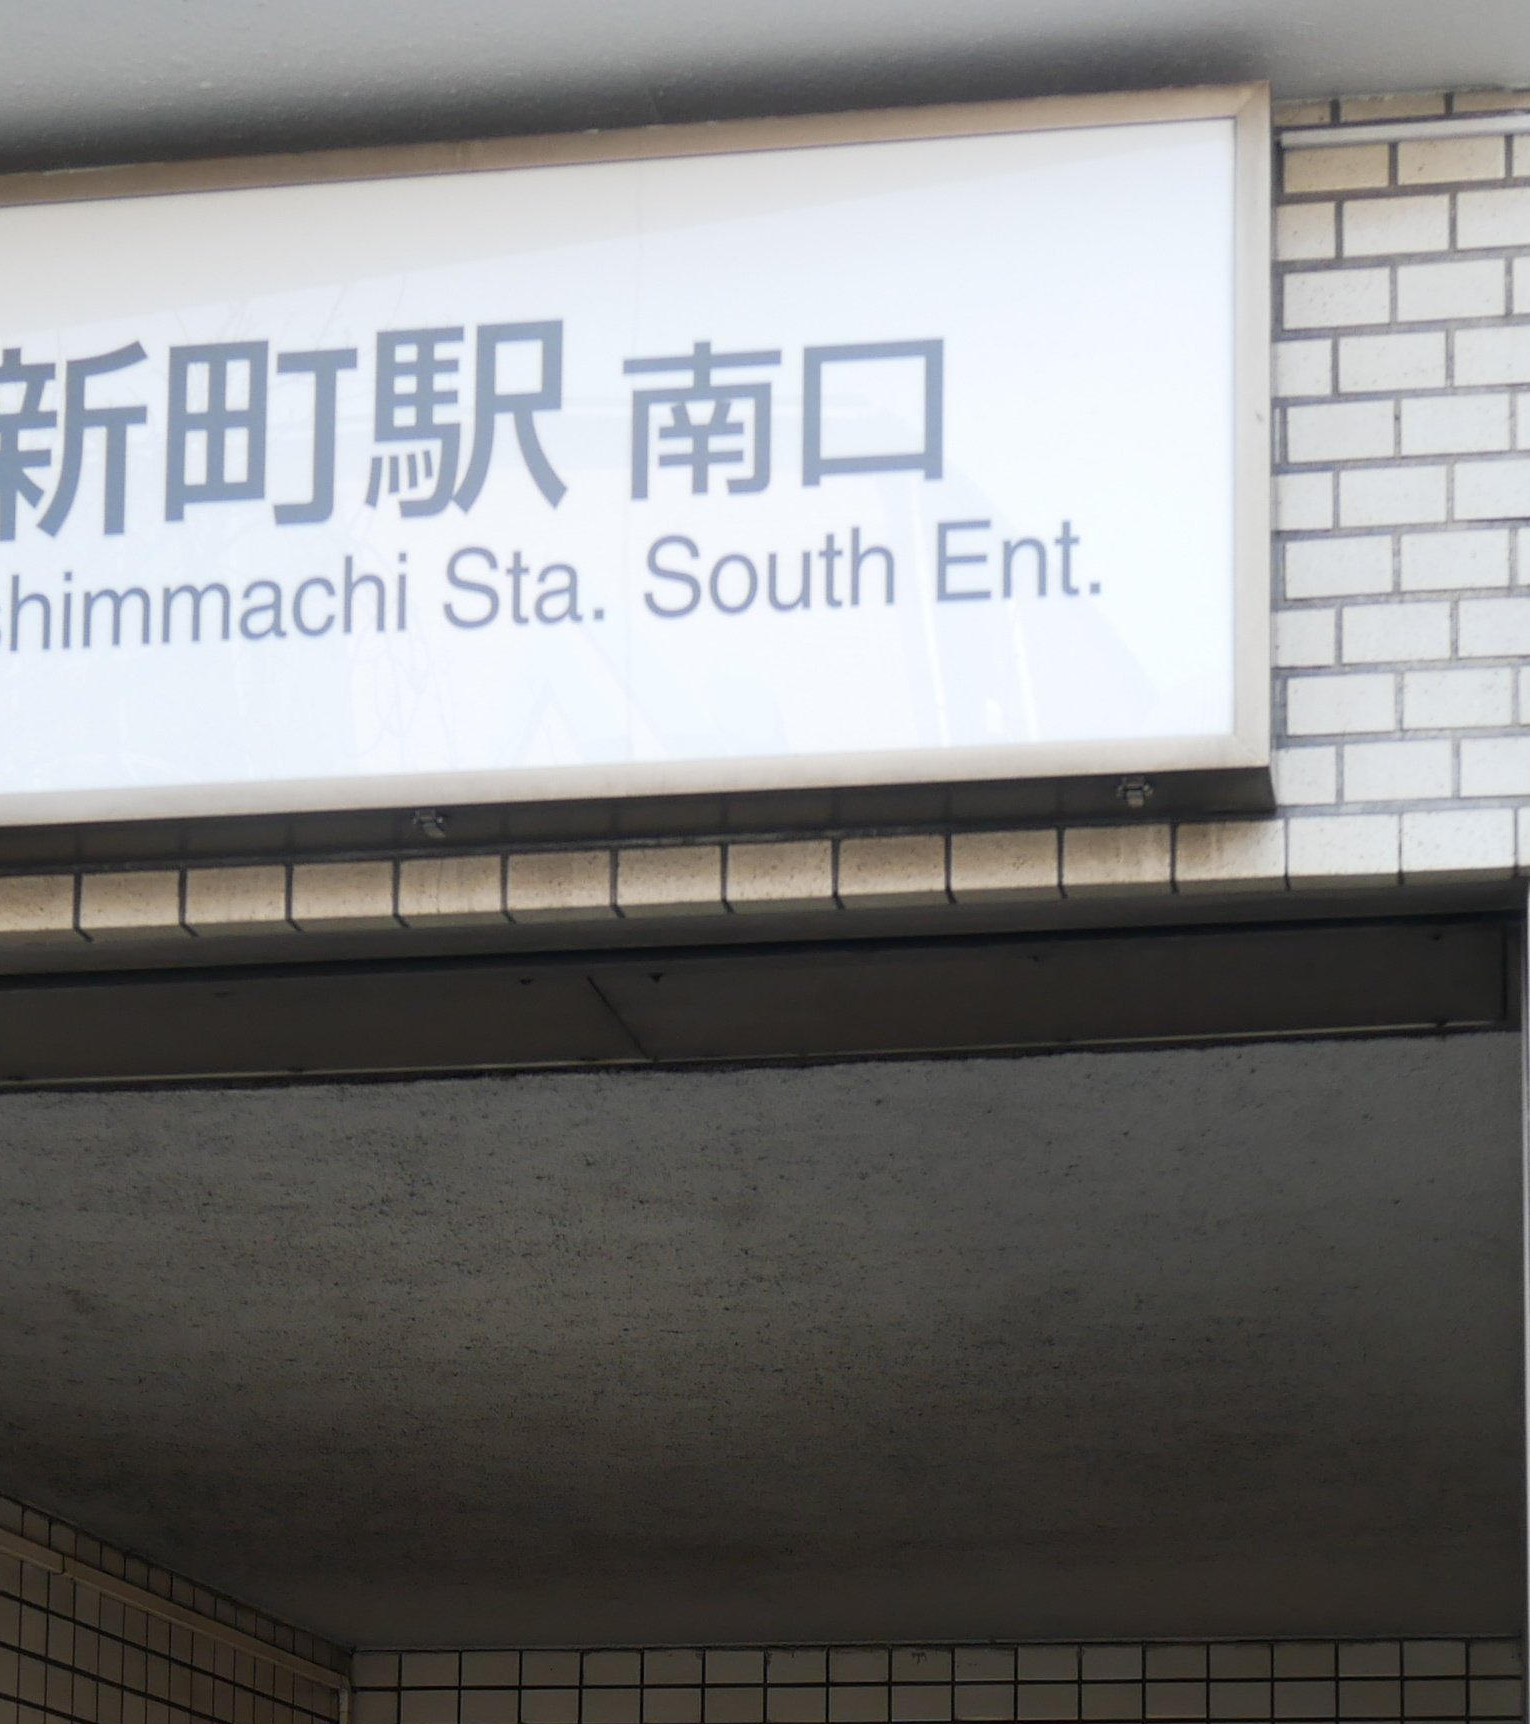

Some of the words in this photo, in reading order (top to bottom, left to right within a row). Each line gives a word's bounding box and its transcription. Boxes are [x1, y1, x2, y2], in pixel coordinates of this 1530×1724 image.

[619, 338, 947, 503] 南口
[442, 544, 607, 632] Sta.
[639, 525, 899, 622] South
[935, 509, 1104, 610] Ent.
